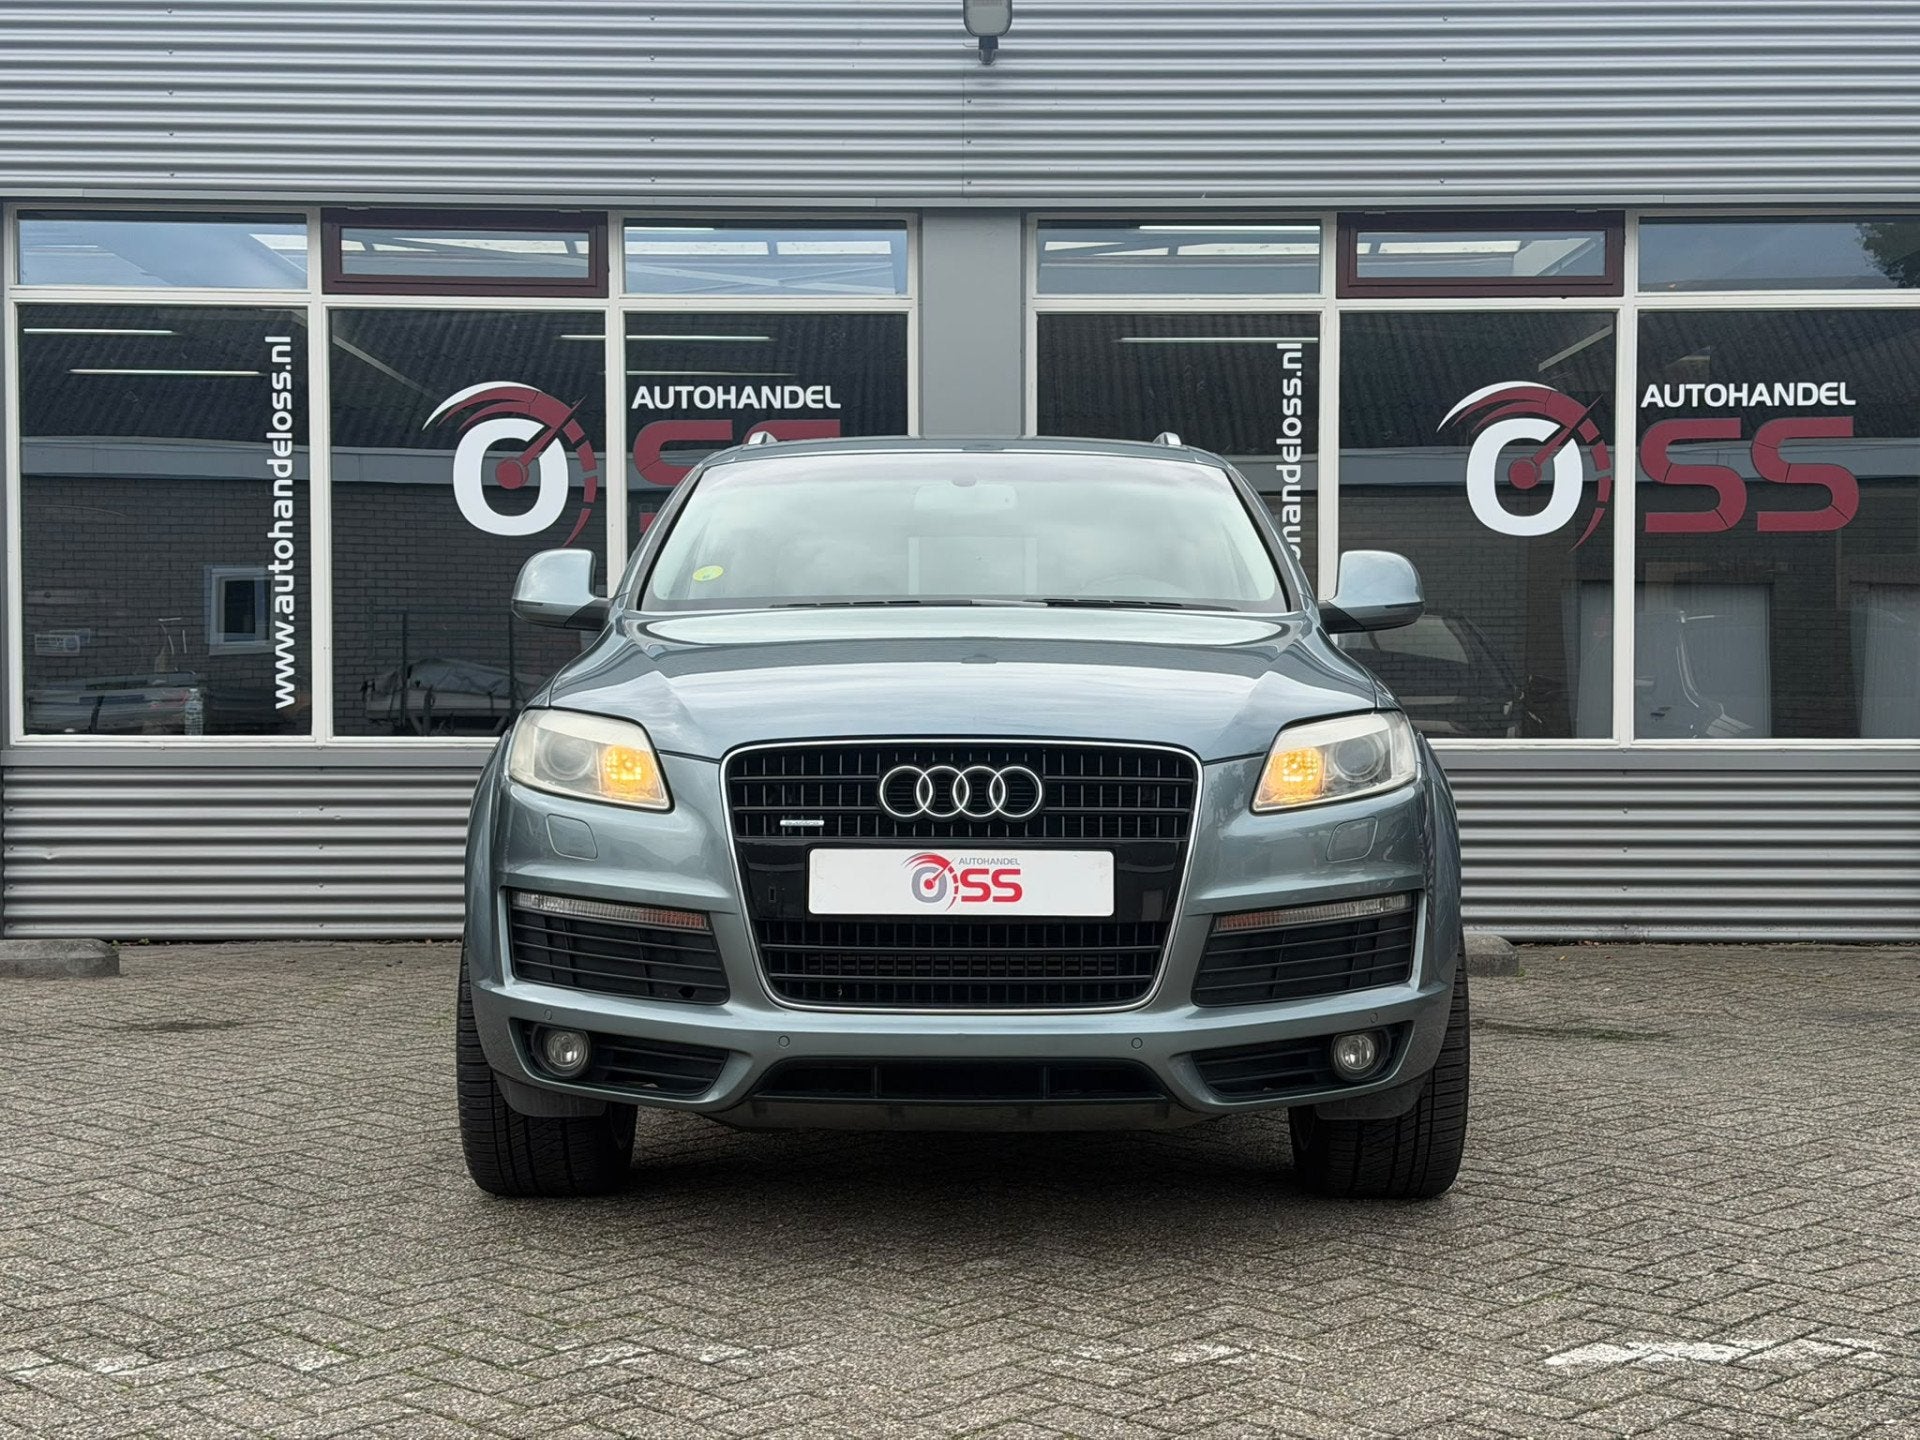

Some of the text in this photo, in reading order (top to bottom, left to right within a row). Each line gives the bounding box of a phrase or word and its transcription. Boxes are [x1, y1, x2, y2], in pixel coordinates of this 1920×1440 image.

[631, 385, 842, 410] AUTOHANDEL
[1640, 381, 1857, 408] AUTOHANDEL
[1275, 342, 1303, 560] handeloss.nl
[1466, 417, 1860, 537] OSS
[264, 336, 295, 709] www.autohandeloss.nl
[958, 857, 1021, 866] AUTOHANDEL
[911, 866, 1023, 903] OSS
